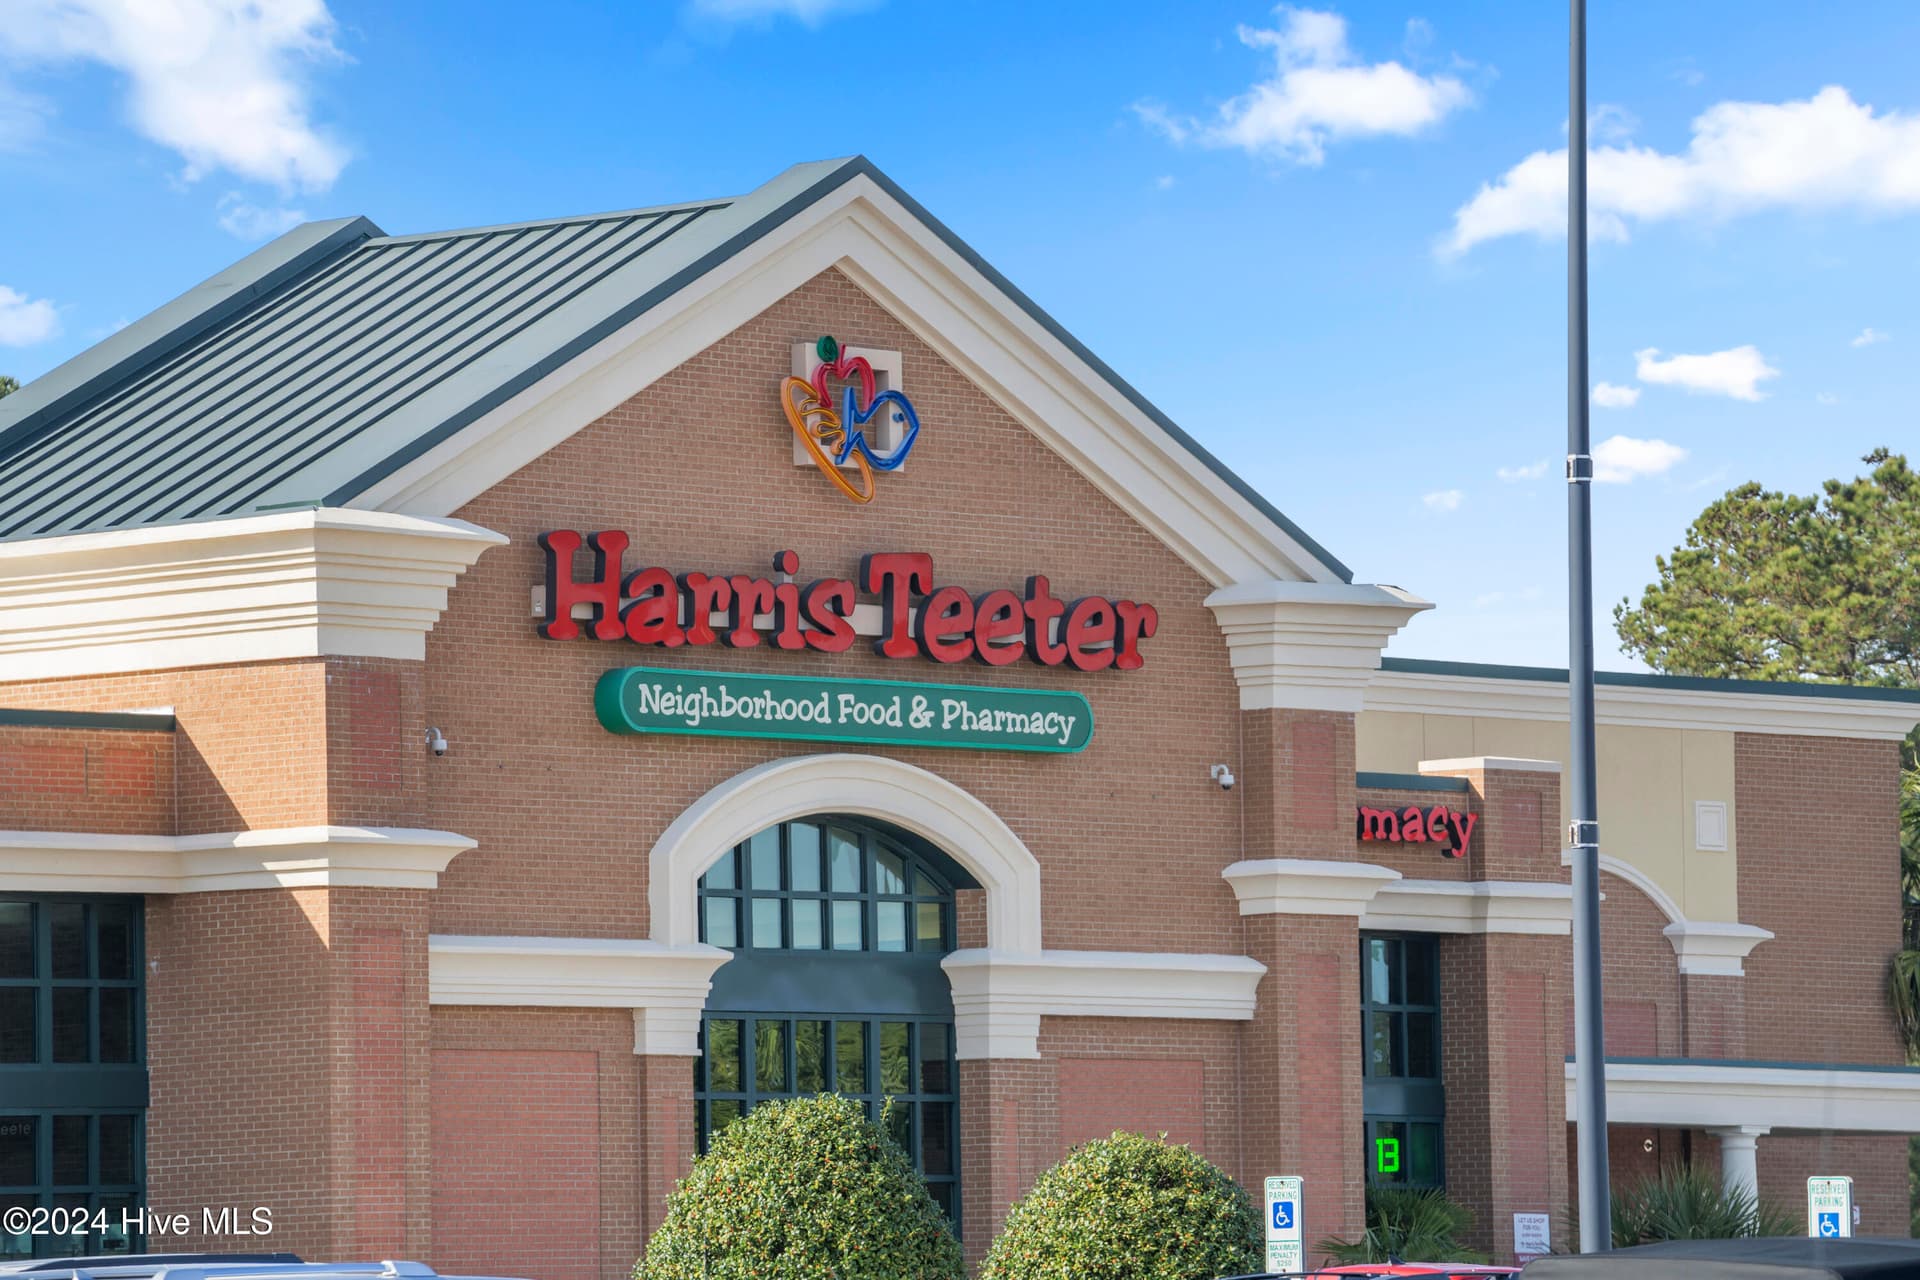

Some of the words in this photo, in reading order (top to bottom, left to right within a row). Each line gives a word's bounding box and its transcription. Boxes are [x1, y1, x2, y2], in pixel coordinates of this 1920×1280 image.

[538, 529, 855, 651] Harris
[861, 552, 1157, 672] Teeter
[639, 684, 831, 726] Neighborhood
[837, 694, 902, 727] Food
[909, 695, 935, 729] &
[941, 699, 1076, 745] Pharmacy
[1357, 805, 1479, 859] macy
[1375, 1137, 1399, 1173] 13
[1268, 1180, 1297, 1190] RESERVED
[1268, 1191, 1298, 1201] PARKING
[1811, 1183, 1846, 1194] RESERVED
[1814, 1196, 1844, 1208] PARKING
